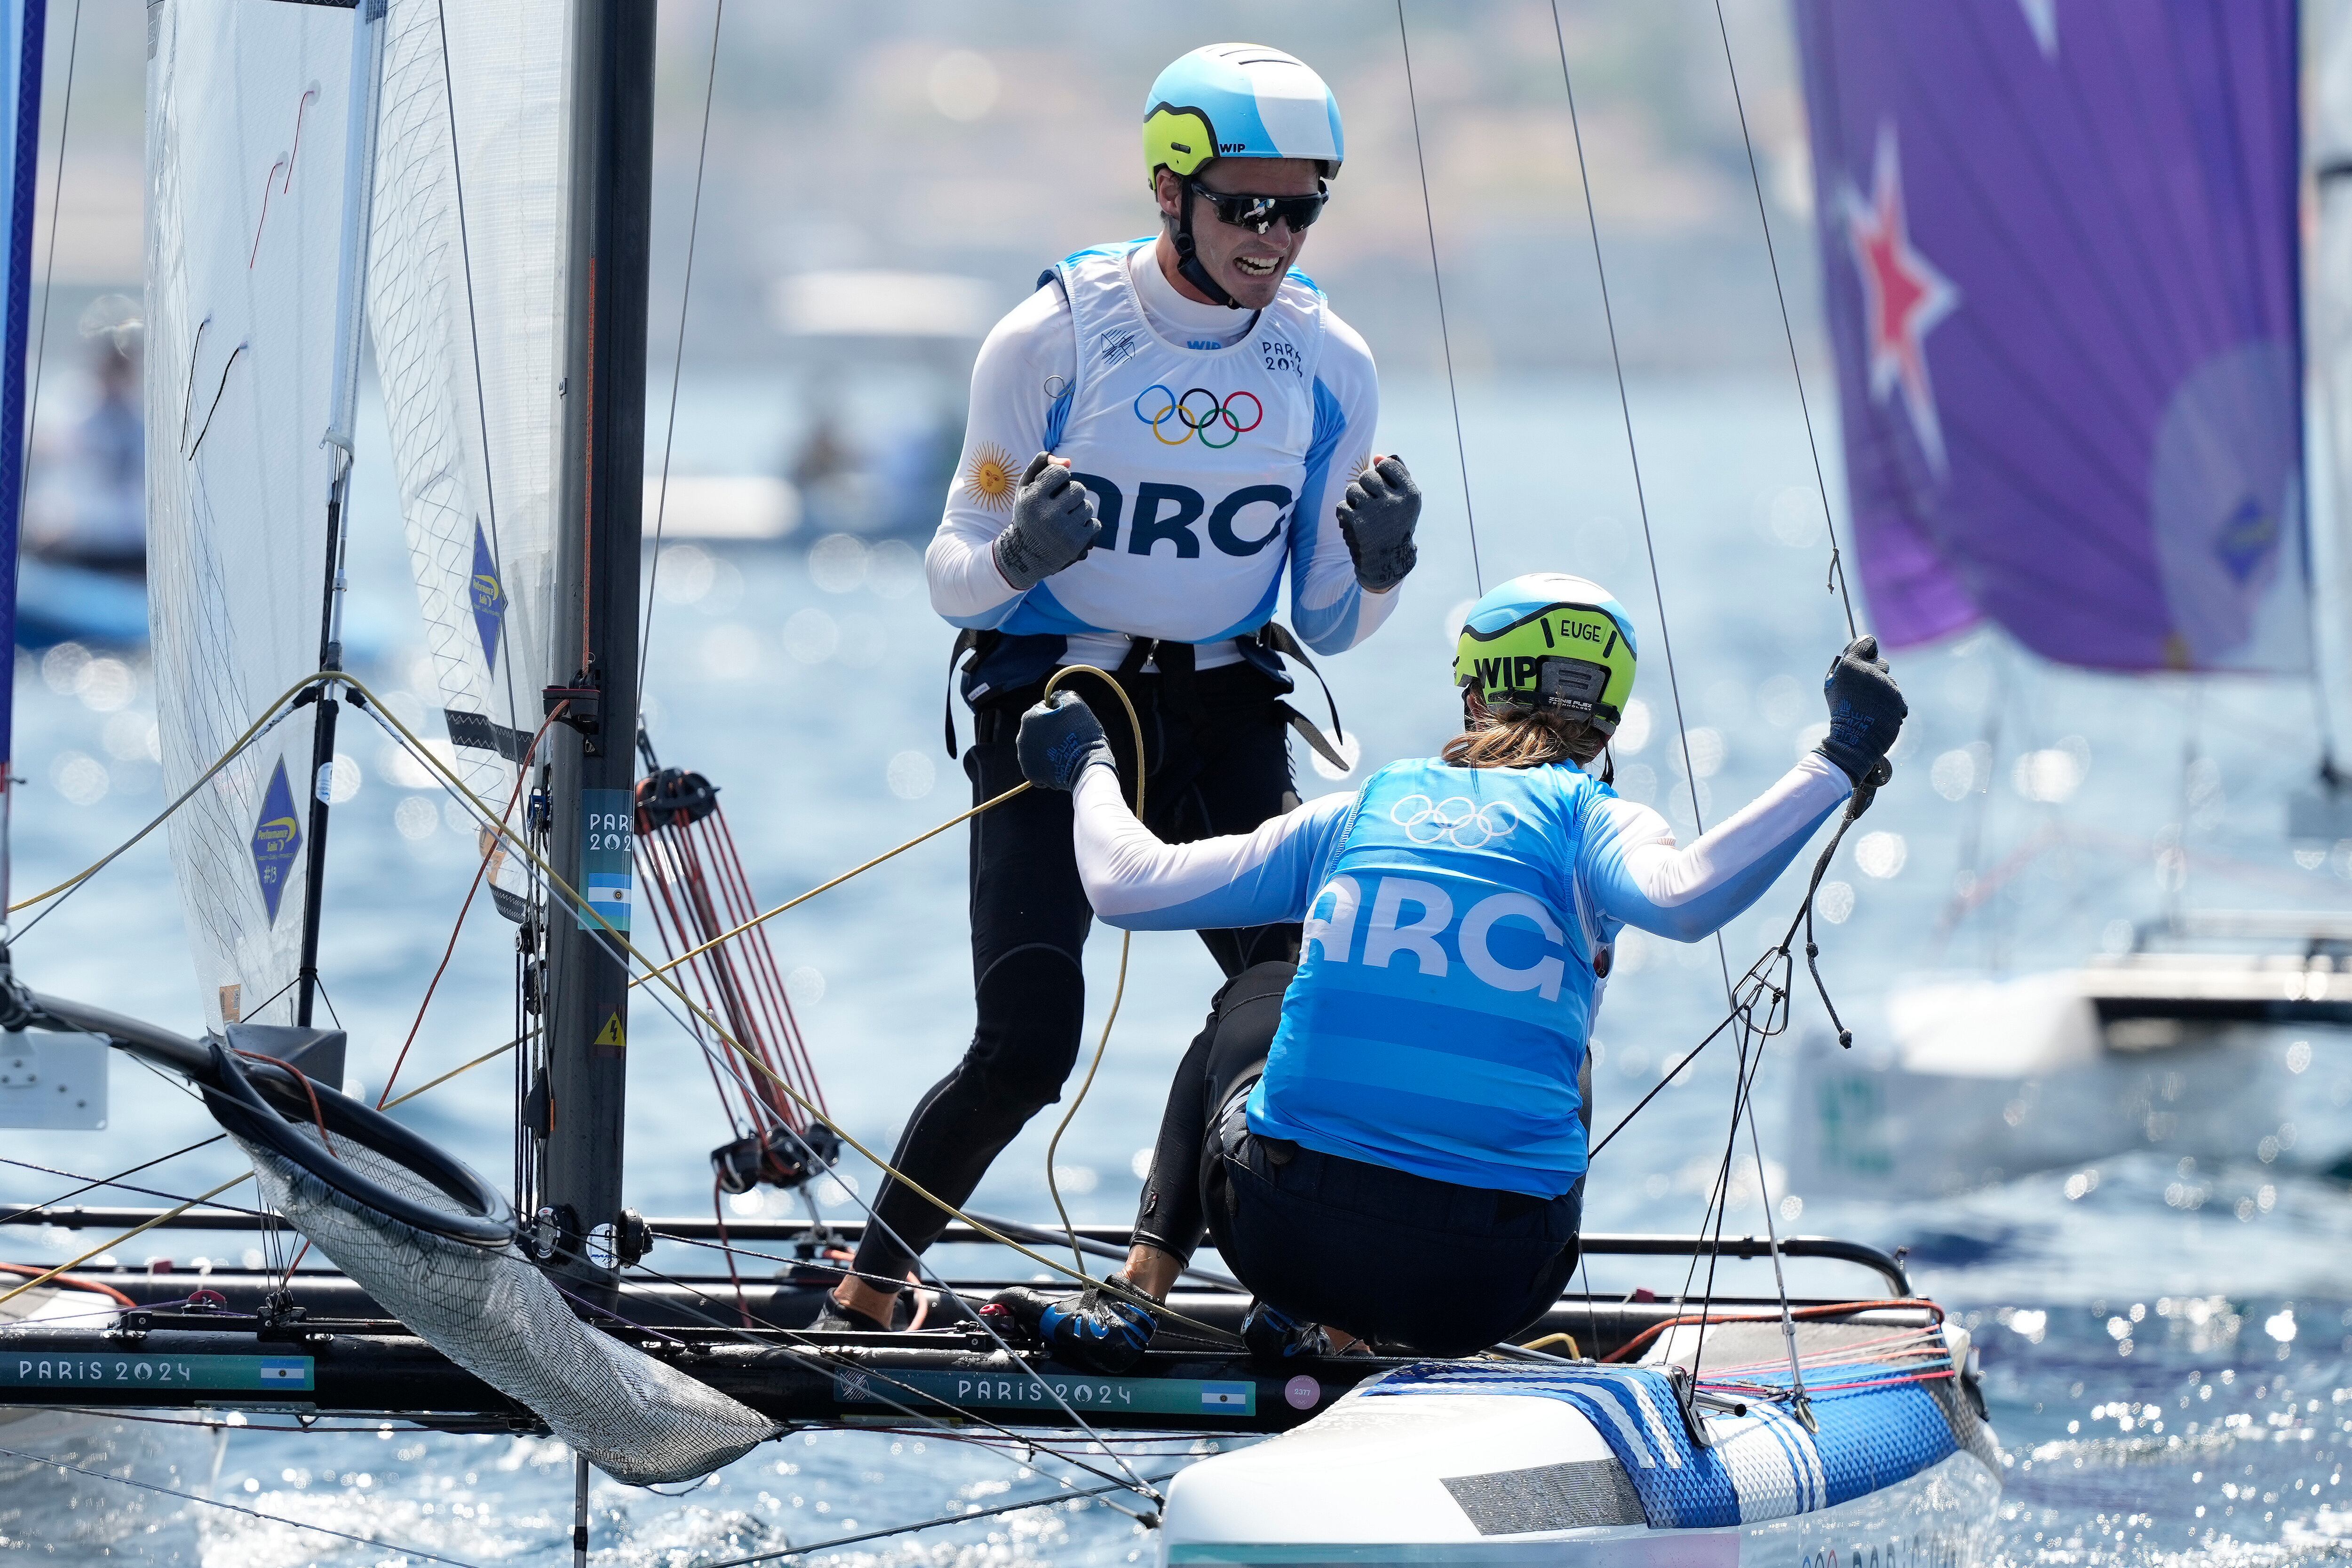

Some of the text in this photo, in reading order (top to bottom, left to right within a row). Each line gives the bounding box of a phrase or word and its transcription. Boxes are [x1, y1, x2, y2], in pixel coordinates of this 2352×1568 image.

[1219, 143, 1246, 153] WIP
[1187, 341, 1222, 350] WIP
[1561, 619, 1602, 643] EUGE
[1474, 656, 1537, 689] WIP
[589, 833, 631, 852] 202
[1297, 873, 1565, 1003] ARG
[115, 1362, 191, 1381] 2024
[1055, 1383, 1131, 1404] 2024
[1294, 1388, 1311, 1396] 2377
